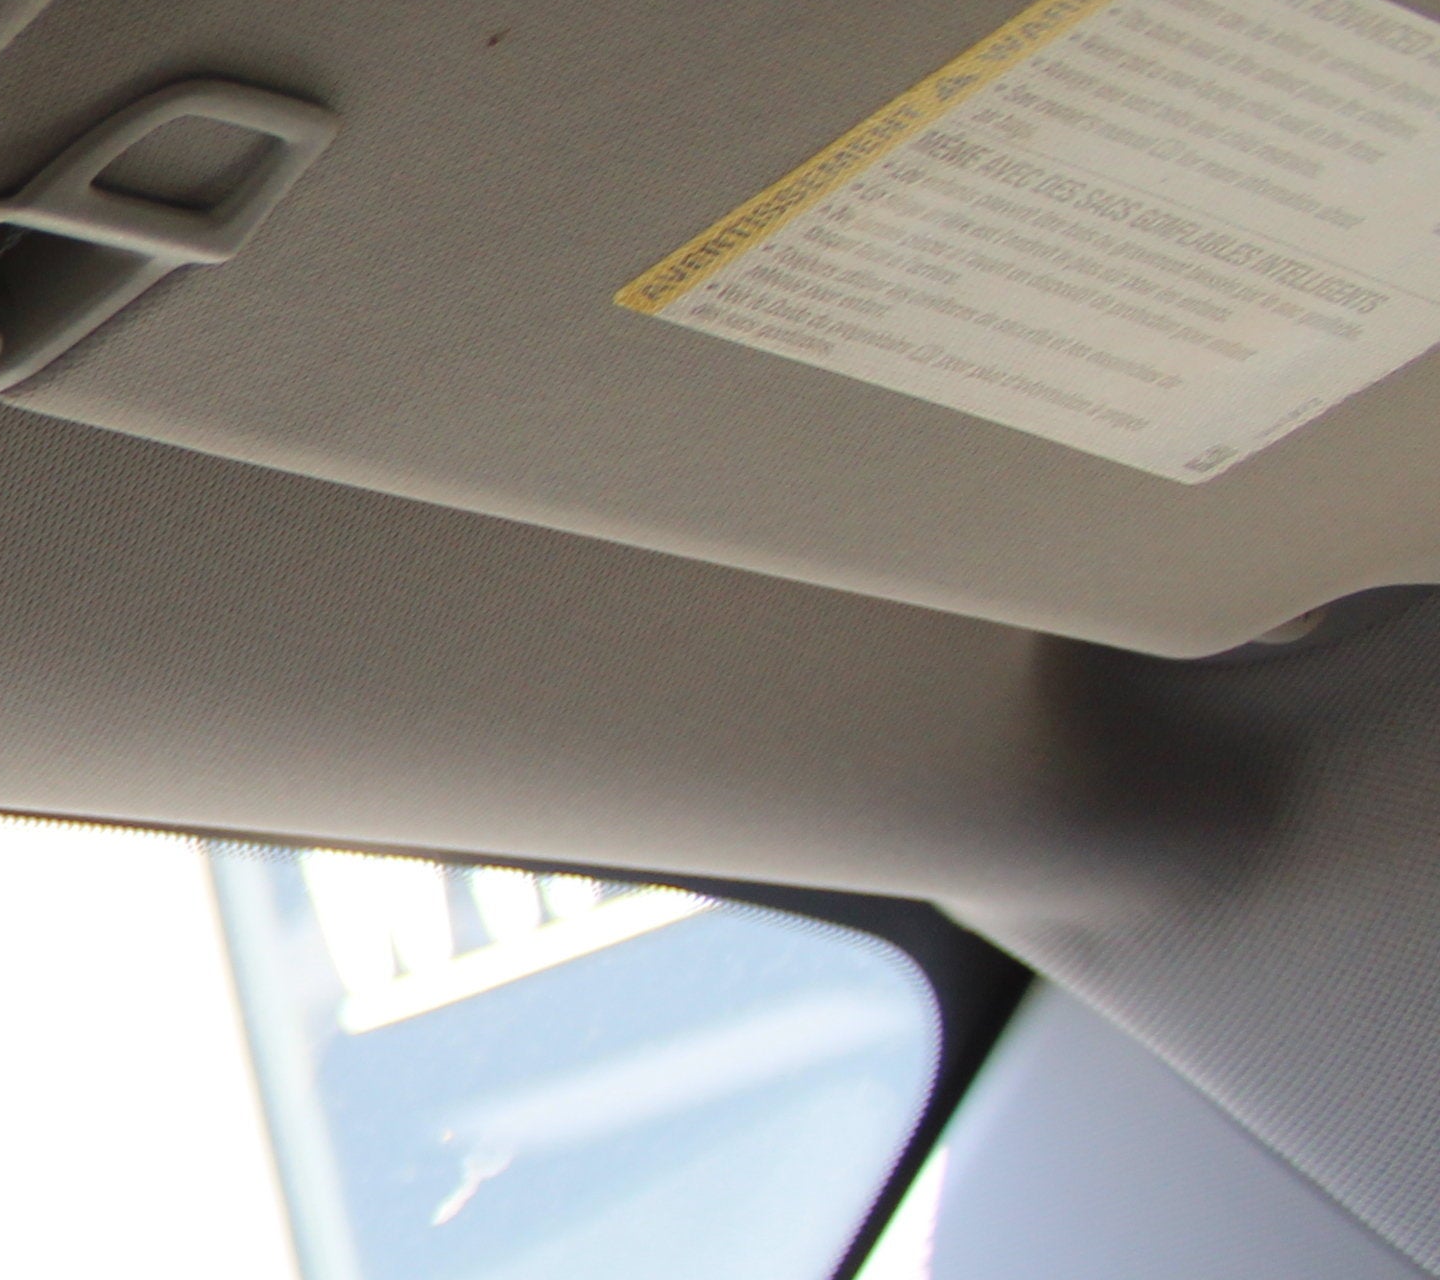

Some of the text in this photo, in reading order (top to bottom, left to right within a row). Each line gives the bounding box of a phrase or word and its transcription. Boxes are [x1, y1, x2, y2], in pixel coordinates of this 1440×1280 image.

[972, 153, 1048, 188] AVEC
[1028, 173, 1089, 203] DES
[1069, 188, 1144, 222] SACS
[1122, 208, 1268, 266] GONFLABLES
[1241, 252, 1397, 314] INTELLIGENTS
